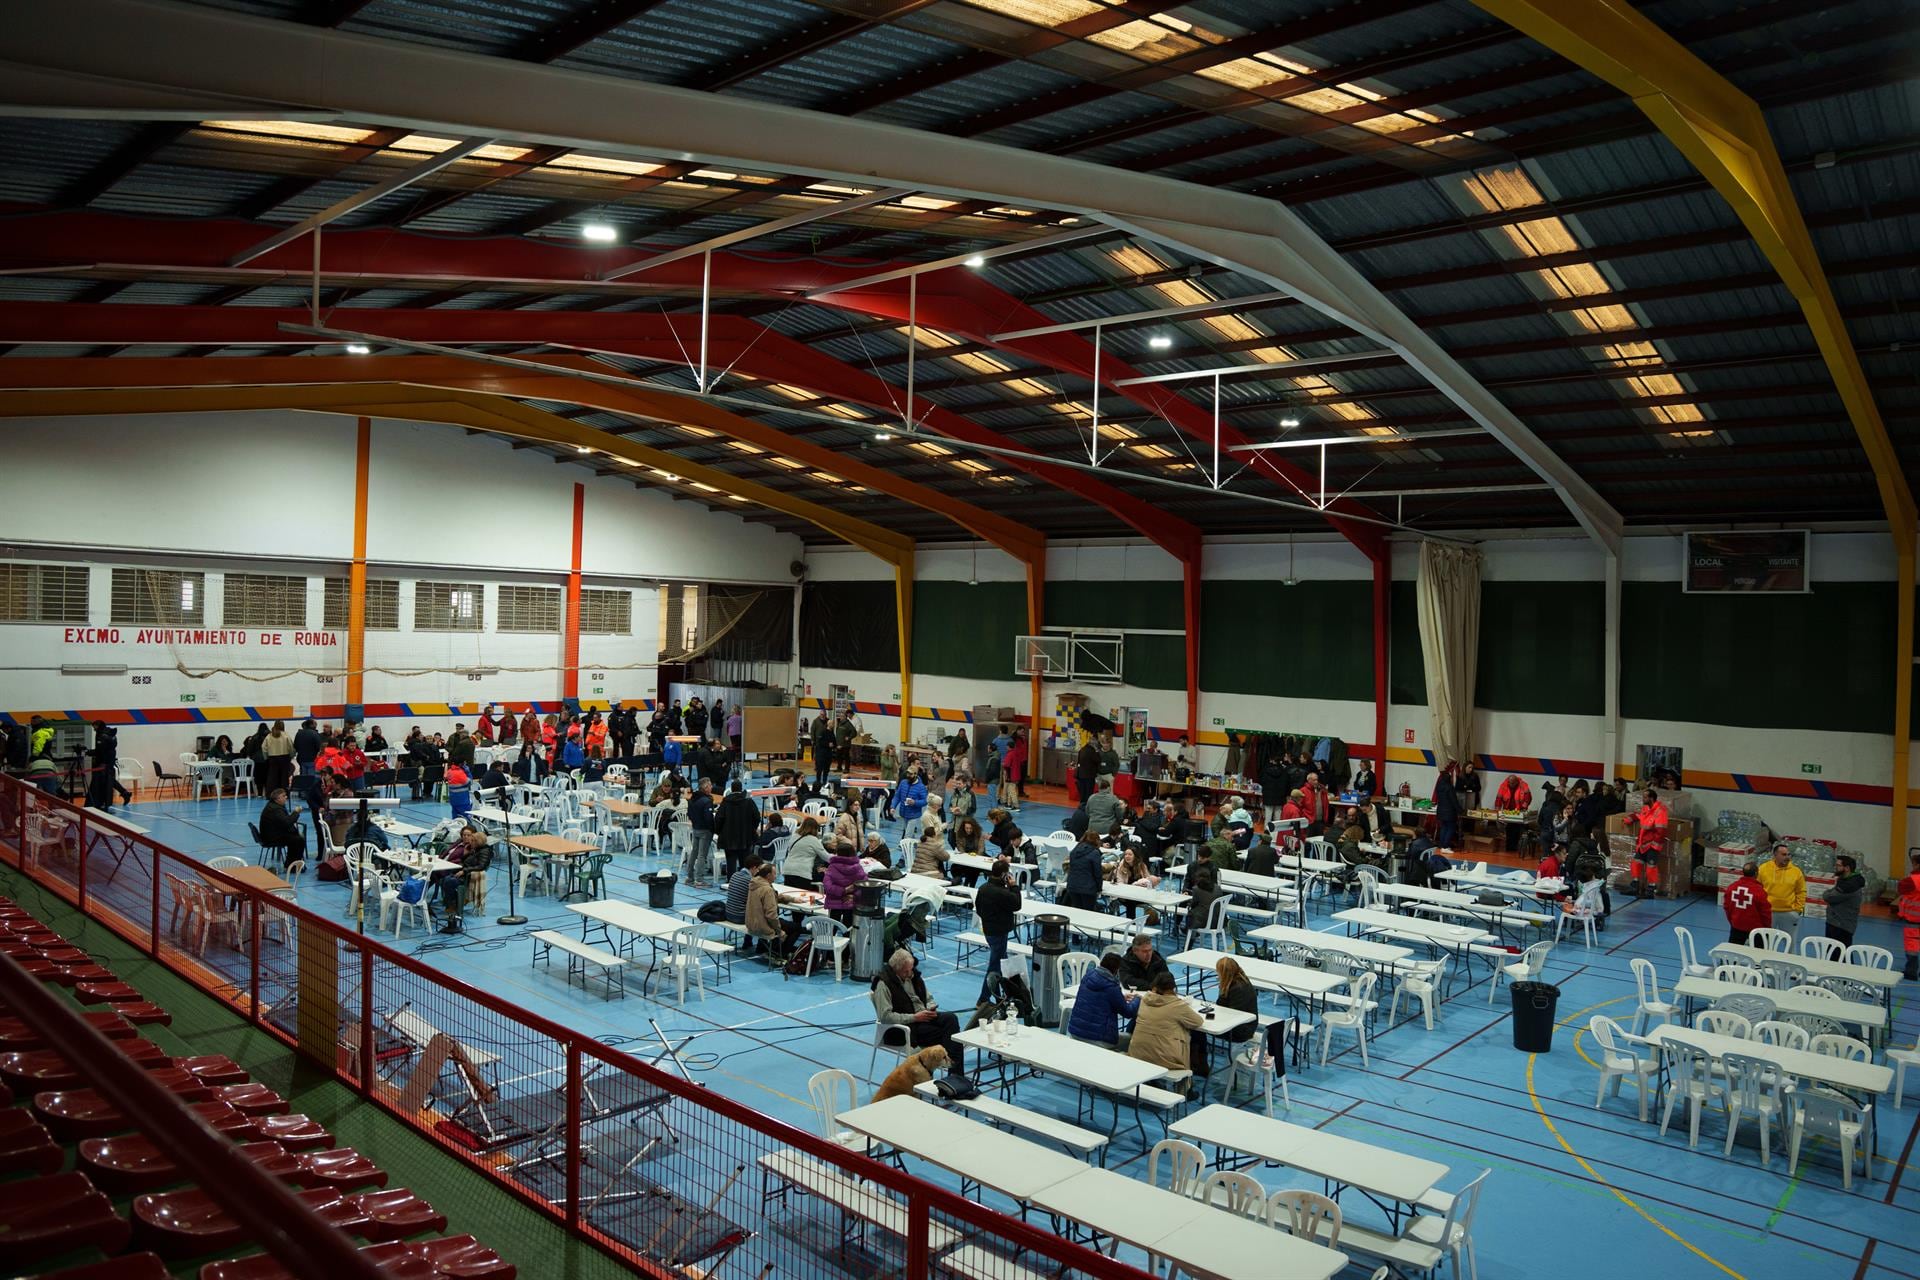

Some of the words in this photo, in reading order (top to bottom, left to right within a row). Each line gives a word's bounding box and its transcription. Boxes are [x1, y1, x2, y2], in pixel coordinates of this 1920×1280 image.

[1694, 558, 1723, 566] LOCAL
[1768, 558, 1799, 566] VISITANTE
[64, 627, 126, 644] EXCMO.
[137, 629, 247, 645] AYUNTAMIENTO
[260, 633, 282, 645] DE
[295, 632, 337, 646] RONDA
